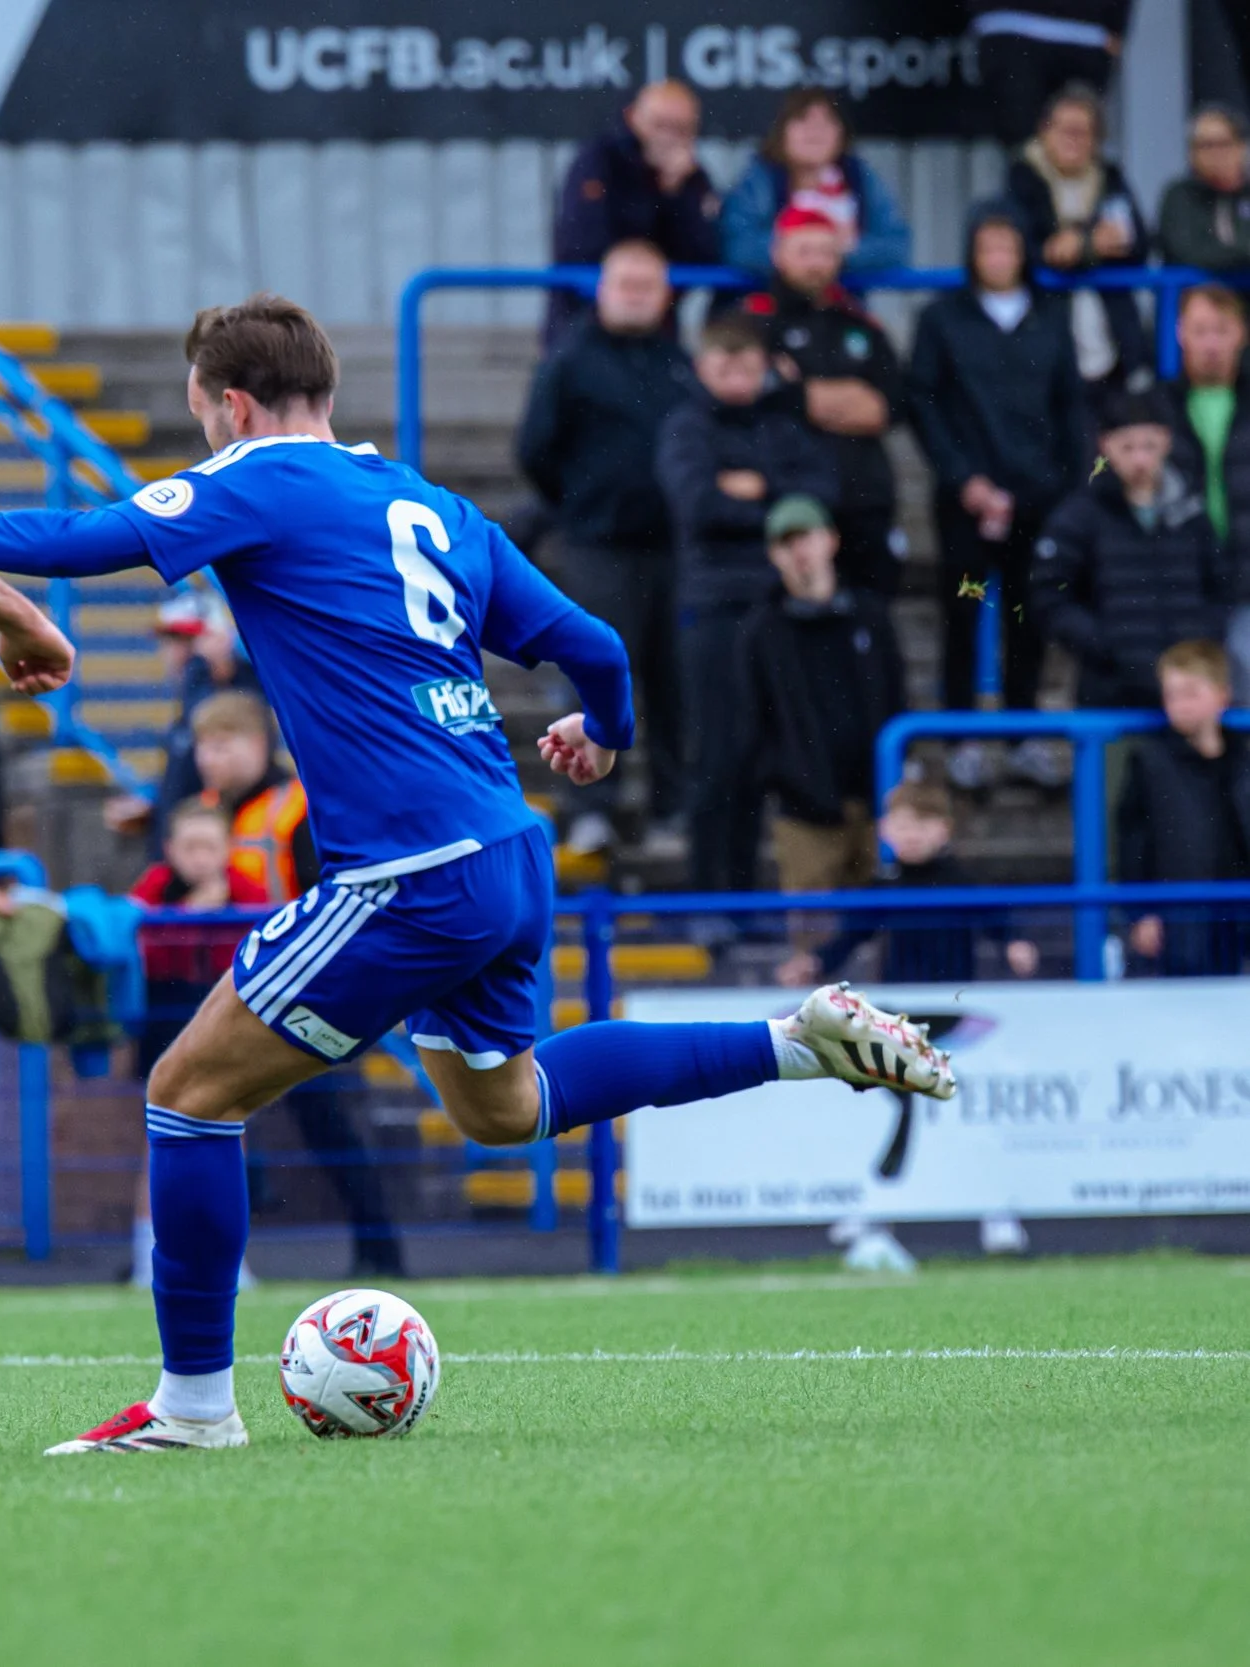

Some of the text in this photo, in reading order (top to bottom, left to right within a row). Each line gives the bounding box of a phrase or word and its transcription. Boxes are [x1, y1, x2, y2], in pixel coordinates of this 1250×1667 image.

[246, 25, 981, 100] UCFB.ac.uk GIS.sport
[387, 499, 466, 649] 6
[924, 1070, 1092, 1124] ERRY
